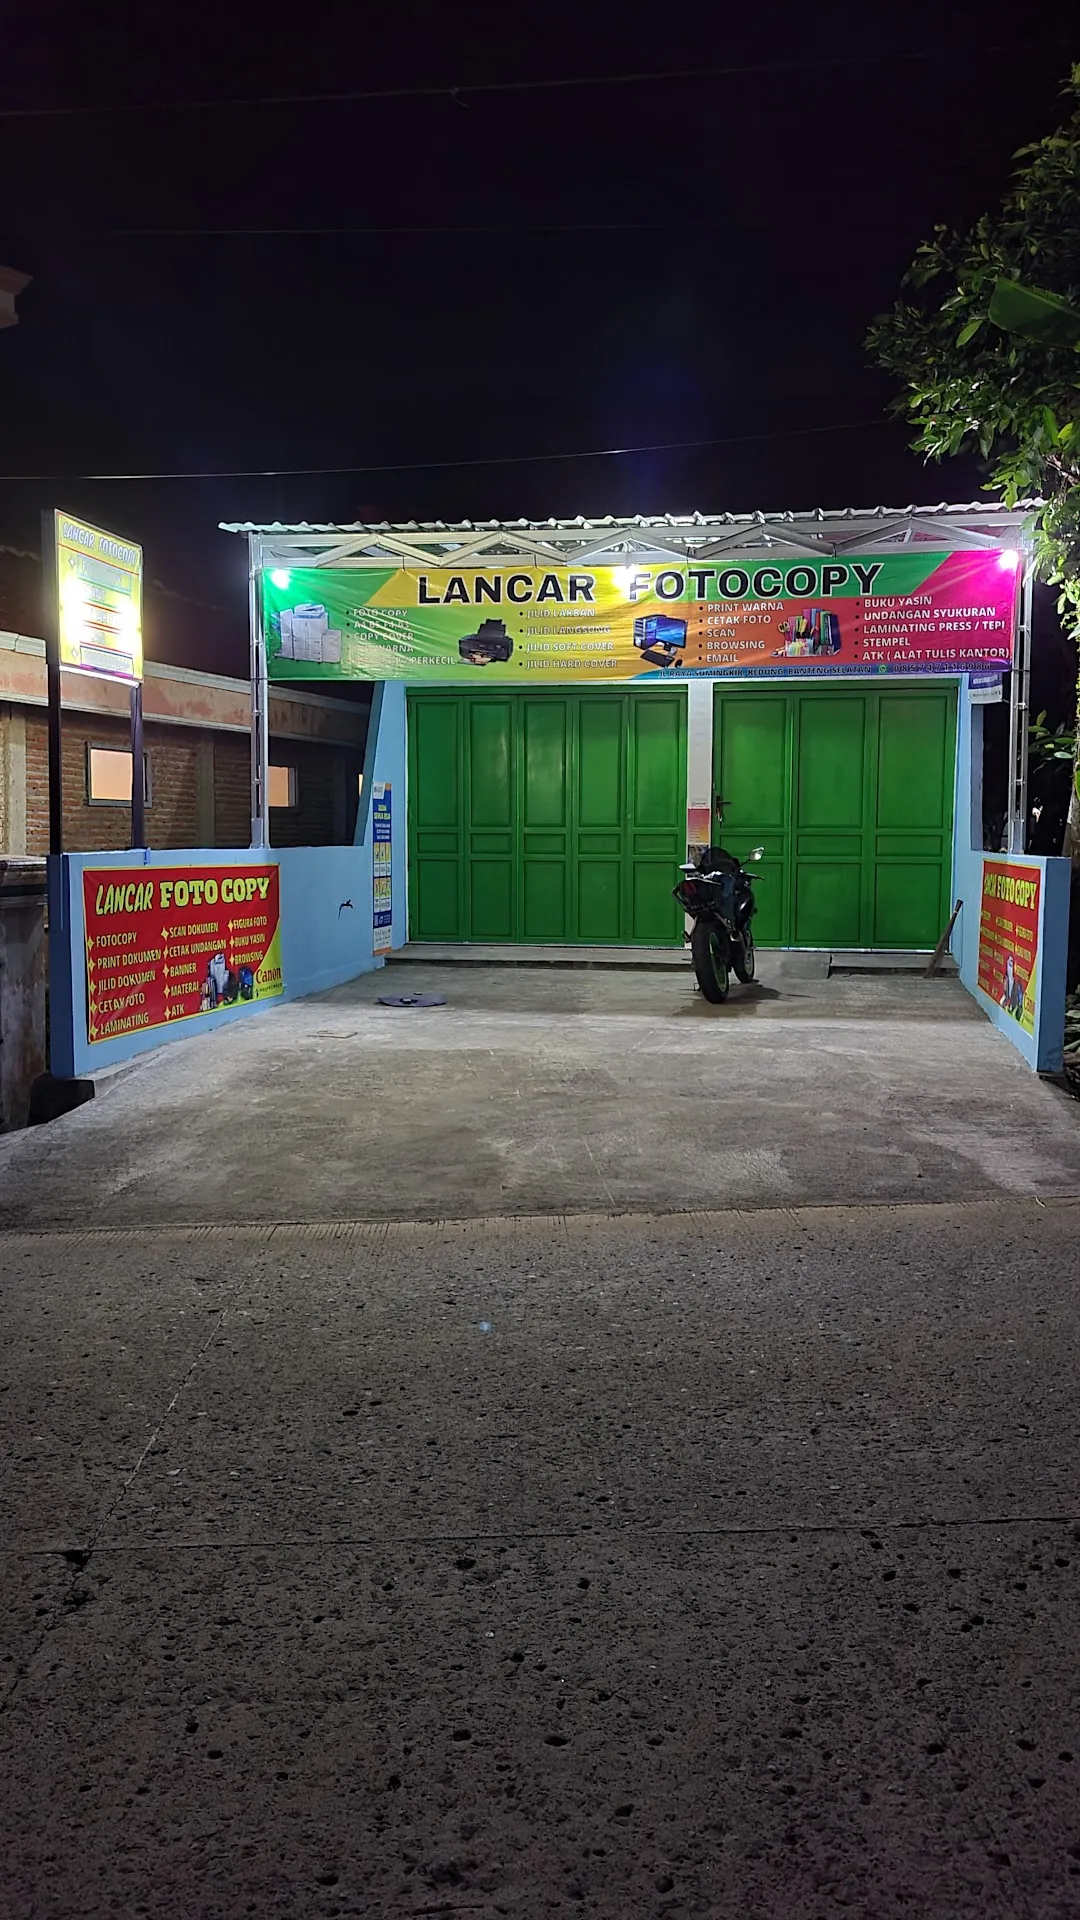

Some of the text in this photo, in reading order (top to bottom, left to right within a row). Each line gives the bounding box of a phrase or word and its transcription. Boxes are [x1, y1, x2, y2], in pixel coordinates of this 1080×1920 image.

[418, 562, 884, 605] LANCAR FOTOCOPY
[707, 602, 784, 612] PRINT WARNA
[864, 596, 932, 608] BUKU YASIN
[382, 609, 408, 617] COPY
[526, 609, 595, 620] JILID LAKBAN
[864, 607, 996, 621] UNDANGAN SYUKURAN
[707, 615, 771, 625] CETAK FOTO
[526, 625, 611, 636] JILID LANGSUNG
[707, 628, 736, 637] SCAN
[863, 623, 936, 634] LAMINATING
[939, 621, 972, 631] PRESS
[982, 621, 1005, 630] TEPI
[354, 632, 414, 641] COPY COVER
[863, 637, 911, 648] STEMPEL
[526, 643, 614, 653] JILID SOFT COVER
[707, 640, 765, 650] BROWSING
[411, 656, 456, 665] PERKECIL
[706, 653, 739, 663] EMAIL
[862, 651, 884, 661] ATK
[893, 650, 921, 660] ALAT
[925, 649, 956, 659] TULIS
[959, 647, 1009, 658] KANTOR)
[526, 660, 618, 670] JILID HARD COVER
[669, 669, 693, 677] RAYA
[694, 668, 743, 677] SUMINGKIR
[748, 668, 784, 676] KEDUNG
[788, 666, 829, 675] BANTENG
[832, 664, 872, 674] SELATAN
[95, 877, 270, 916] LANCAR FOTO COPY
[997, 875, 1015, 904] FOTO
[1015, 879, 1037, 910] COPY
[233, 916, 268, 930] FIGURA FOTO
[169, 922, 219, 939] SCAN DOKUMEN
[96, 932, 138, 948] FOTOCOPY
[234, 933, 266, 948] BUKU YASIN
[169, 939, 227, 958] CETAK UNDANGAN
[97, 949, 162, 970] PRINT DOKUMEN
[234, 951, 264, 966] BROWSING
[170, 962, 197, 977] BANNER
[255, 967, 282, 984] Canon
[98, 970, 156, 996] JILID DOKUMEN
[170, 981, 199, 997] MATERAI
[171, 1004, 185, 1017] ATK
[100, 1012, 149, 1035] LAMINATING
